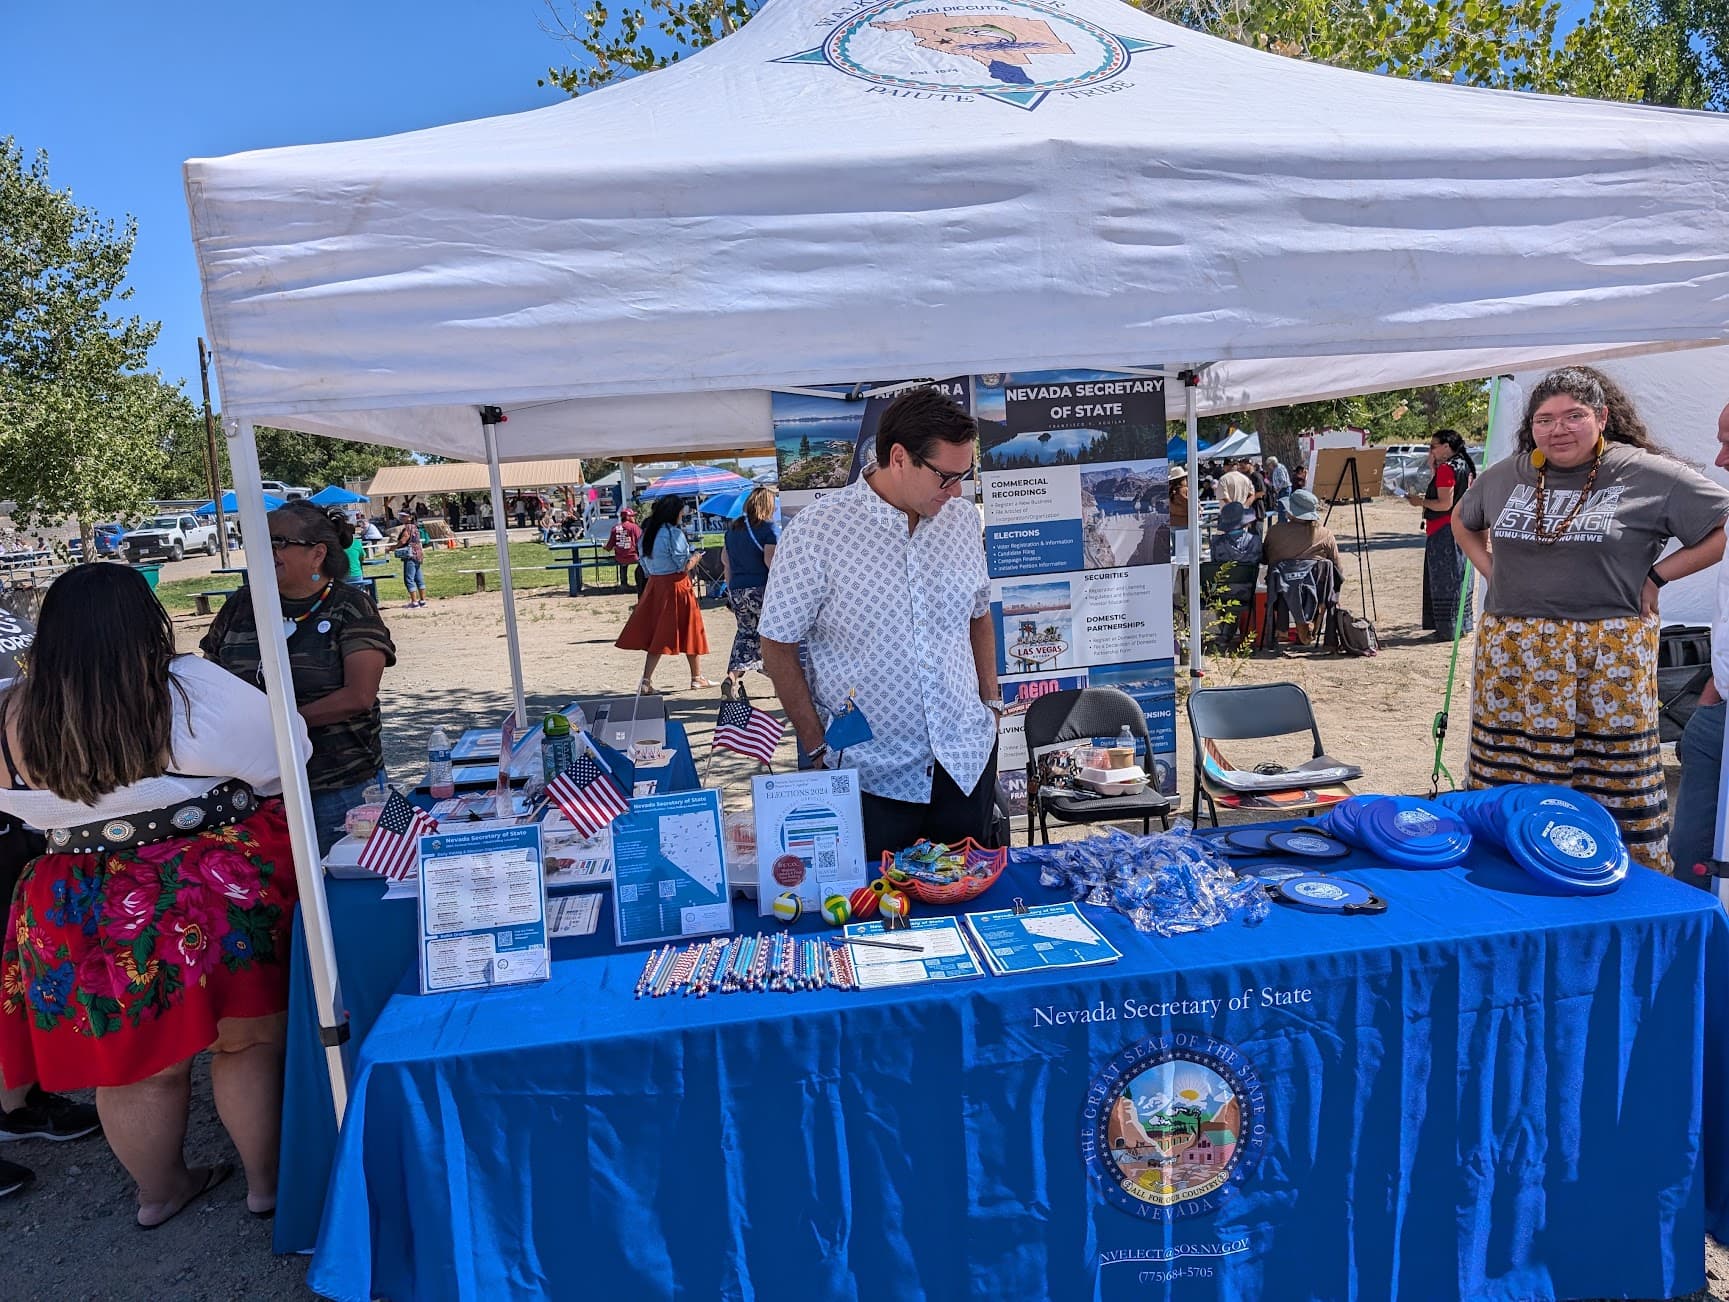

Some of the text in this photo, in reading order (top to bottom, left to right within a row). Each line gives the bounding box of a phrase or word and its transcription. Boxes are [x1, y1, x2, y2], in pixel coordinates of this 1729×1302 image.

[865, 79, 1135, 103] PAIUTE TRIBE
[1006, 380, 1164, 402] NEVADA SECRETARY
[1050, 403, 1122, 419] OF STATE
[991, 478, 1048, 489] COMMERCIAL
[992, 488, 1047, 499] RECORDINGS
[1505, 484, 1625, 516] NATIVE
[993, 529, 1040, 540] ELECTIONS
[1010, 541, 1039, 549] Registration
[1084, 571, 1129, 581] SECURITIES
[1086, 613, 1127, 623] DOMESTIC
[1087, 621, 1145, 632] PARTNERSHIPS
[1018, 648, 1034, 656] LAS
[1035, 645, 1062, 655] VEGAS
[766, 789, 810, 799] ELECTIONS
[445, 836, 470, 844] Nevada
[471, 832, 501, 842] Secretary
[1032, 987, 1312, 1028] Nevada Secretary of State
[1081, 1033, 1266, 1165] THE GREAT SEAL OF THE STATE OF
[1130, 1178, 1220, 1204] ALL FOR OUR COUNTRY
[1136, 1198, 1214, 1222] NEVADA
[1100, 1238, 1249, 1263] NVELECT@SOS.NV.GOV
[1138, 1267, 1213, 1282] (775)684-5705
